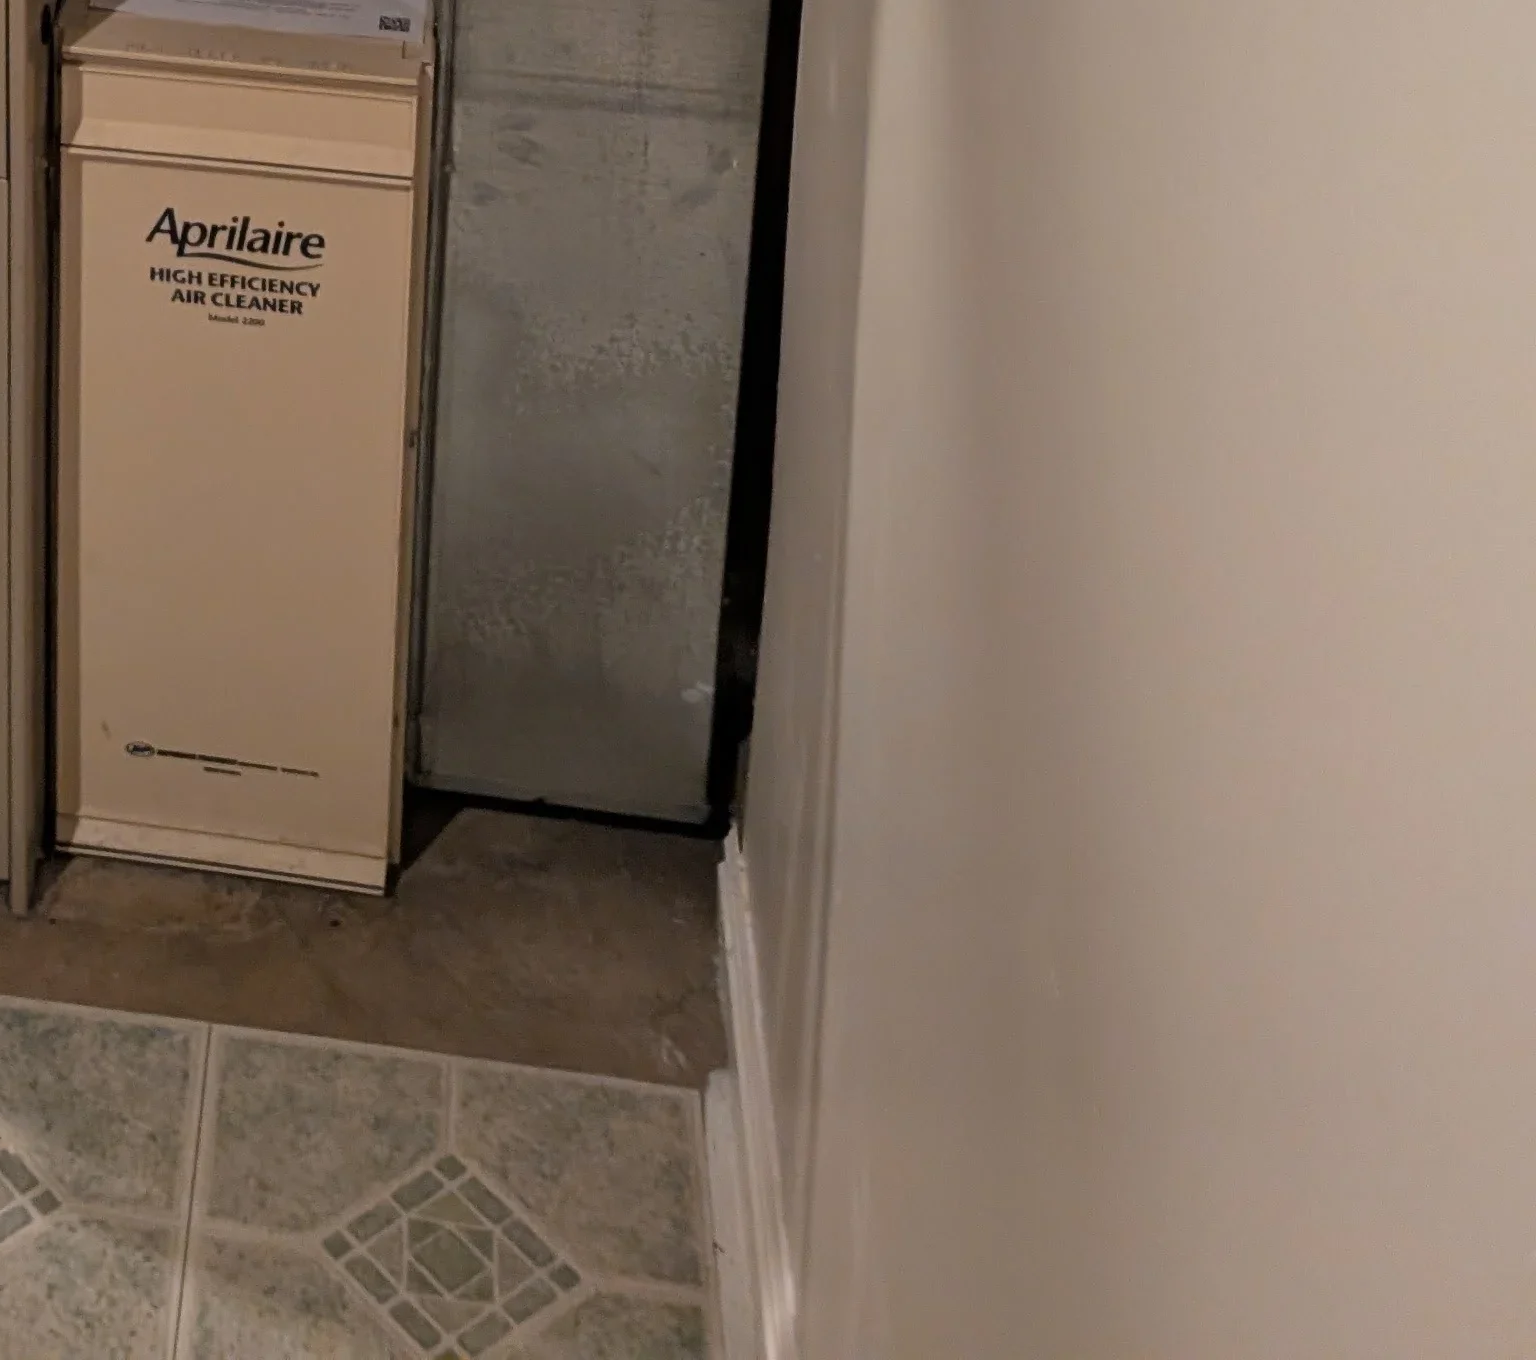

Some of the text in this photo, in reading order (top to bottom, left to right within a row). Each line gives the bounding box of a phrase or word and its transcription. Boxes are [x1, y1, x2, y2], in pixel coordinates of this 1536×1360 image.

[145, 206, 326, 260] Aprilaire
[149, 266, 321, 298] HIGH EFFICIENCY
[170, 287, 304, 315] AIR CLEANER
